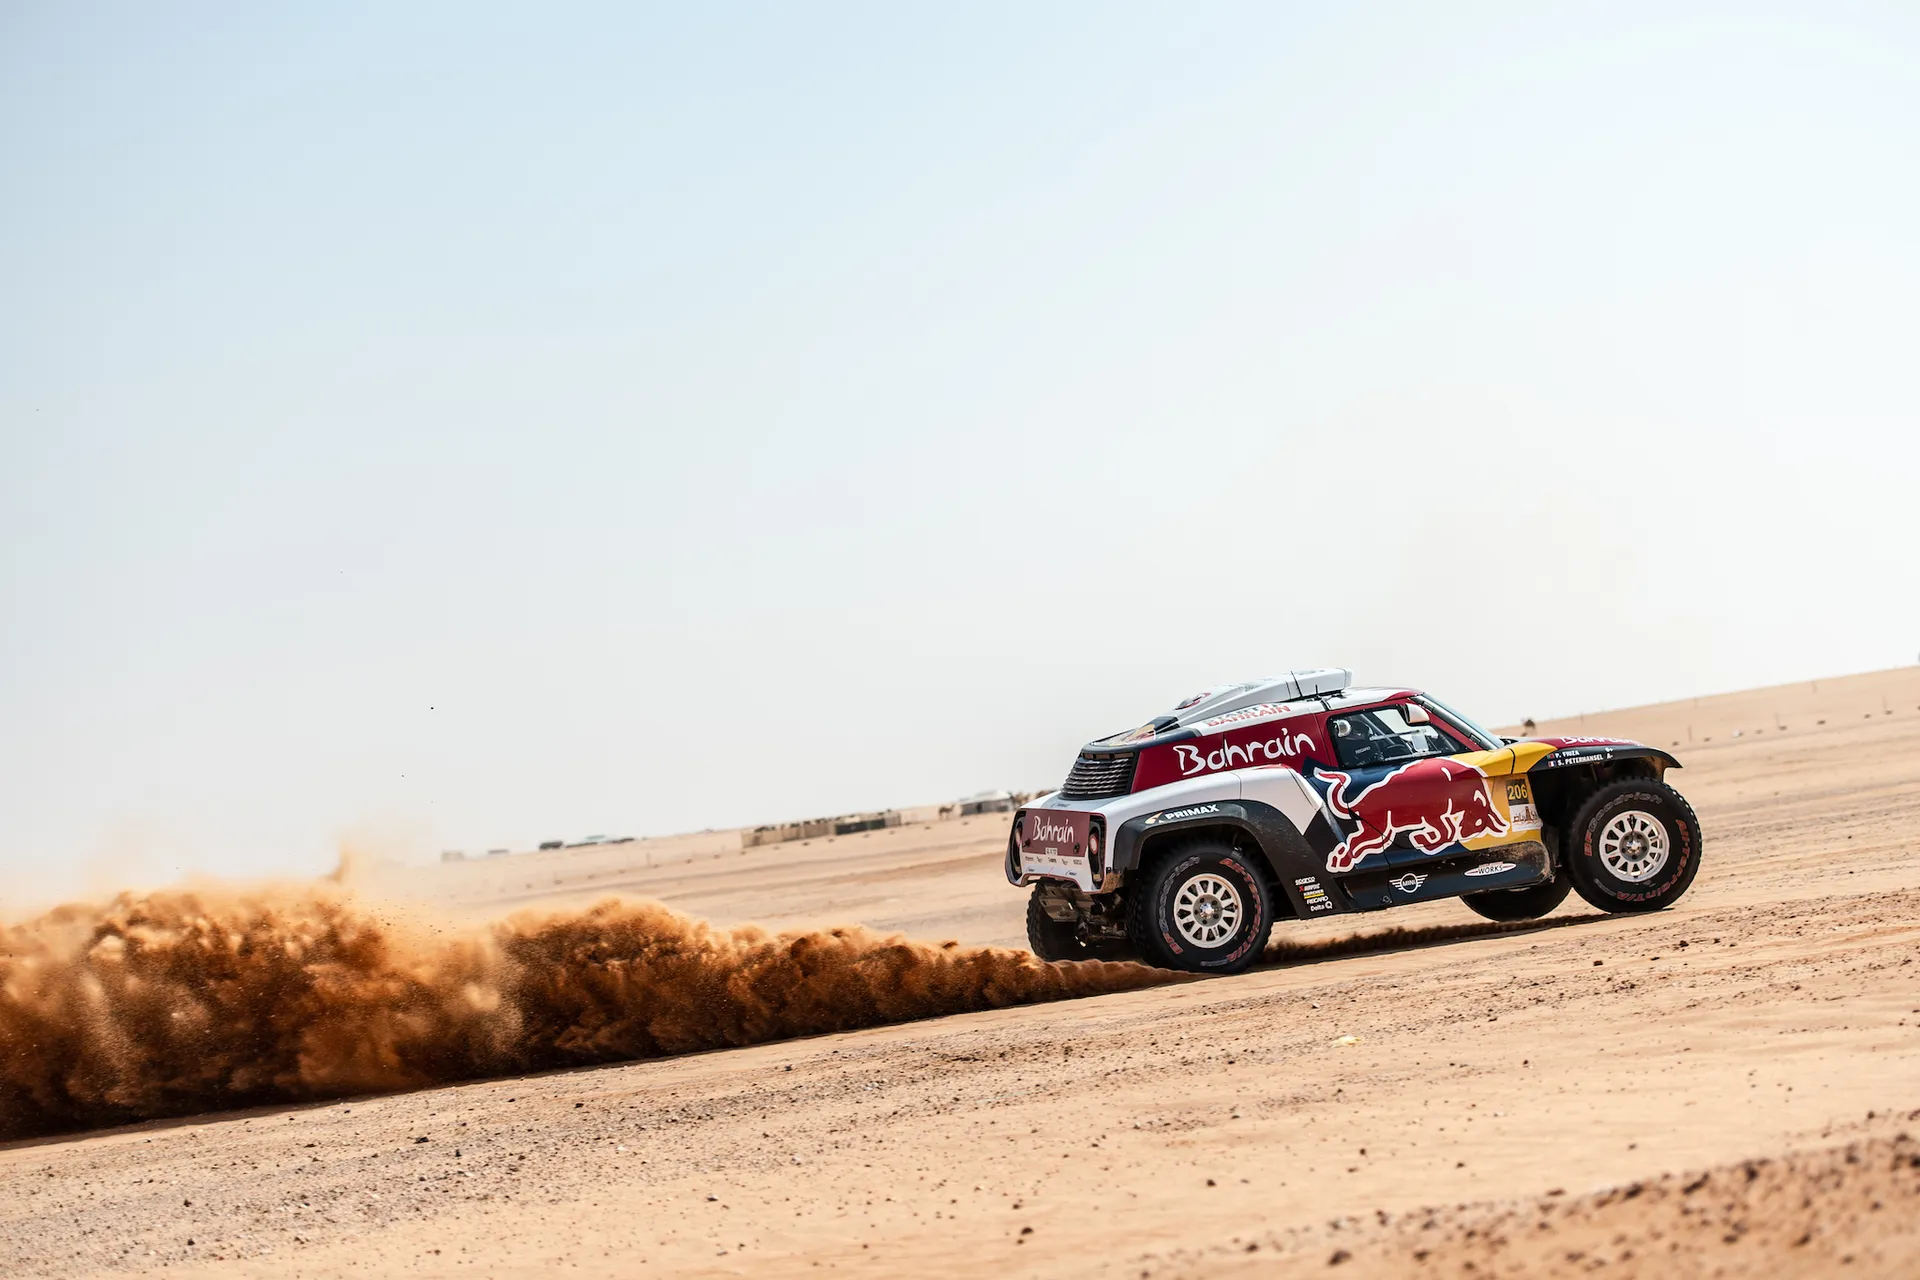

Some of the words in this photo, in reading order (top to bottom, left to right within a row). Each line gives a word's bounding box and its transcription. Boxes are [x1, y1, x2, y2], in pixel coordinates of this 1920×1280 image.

[1207, 705, 1291, 727] BAHRAIN
[1173, 728, 1316, 775] Bahrain
[1565, 754, 1604, 765] PETERHANSEL
[1507, 784, 1528, 800] 206
[1164, 804, 1220, 819] PRIMAX
[1033, 815, 1074, 844] Bahrain
[1478, 865, 1503, 874] WORKS
[1310, 904, 1325, 912] Delta
[1325, 900, 1333, 909] Q
